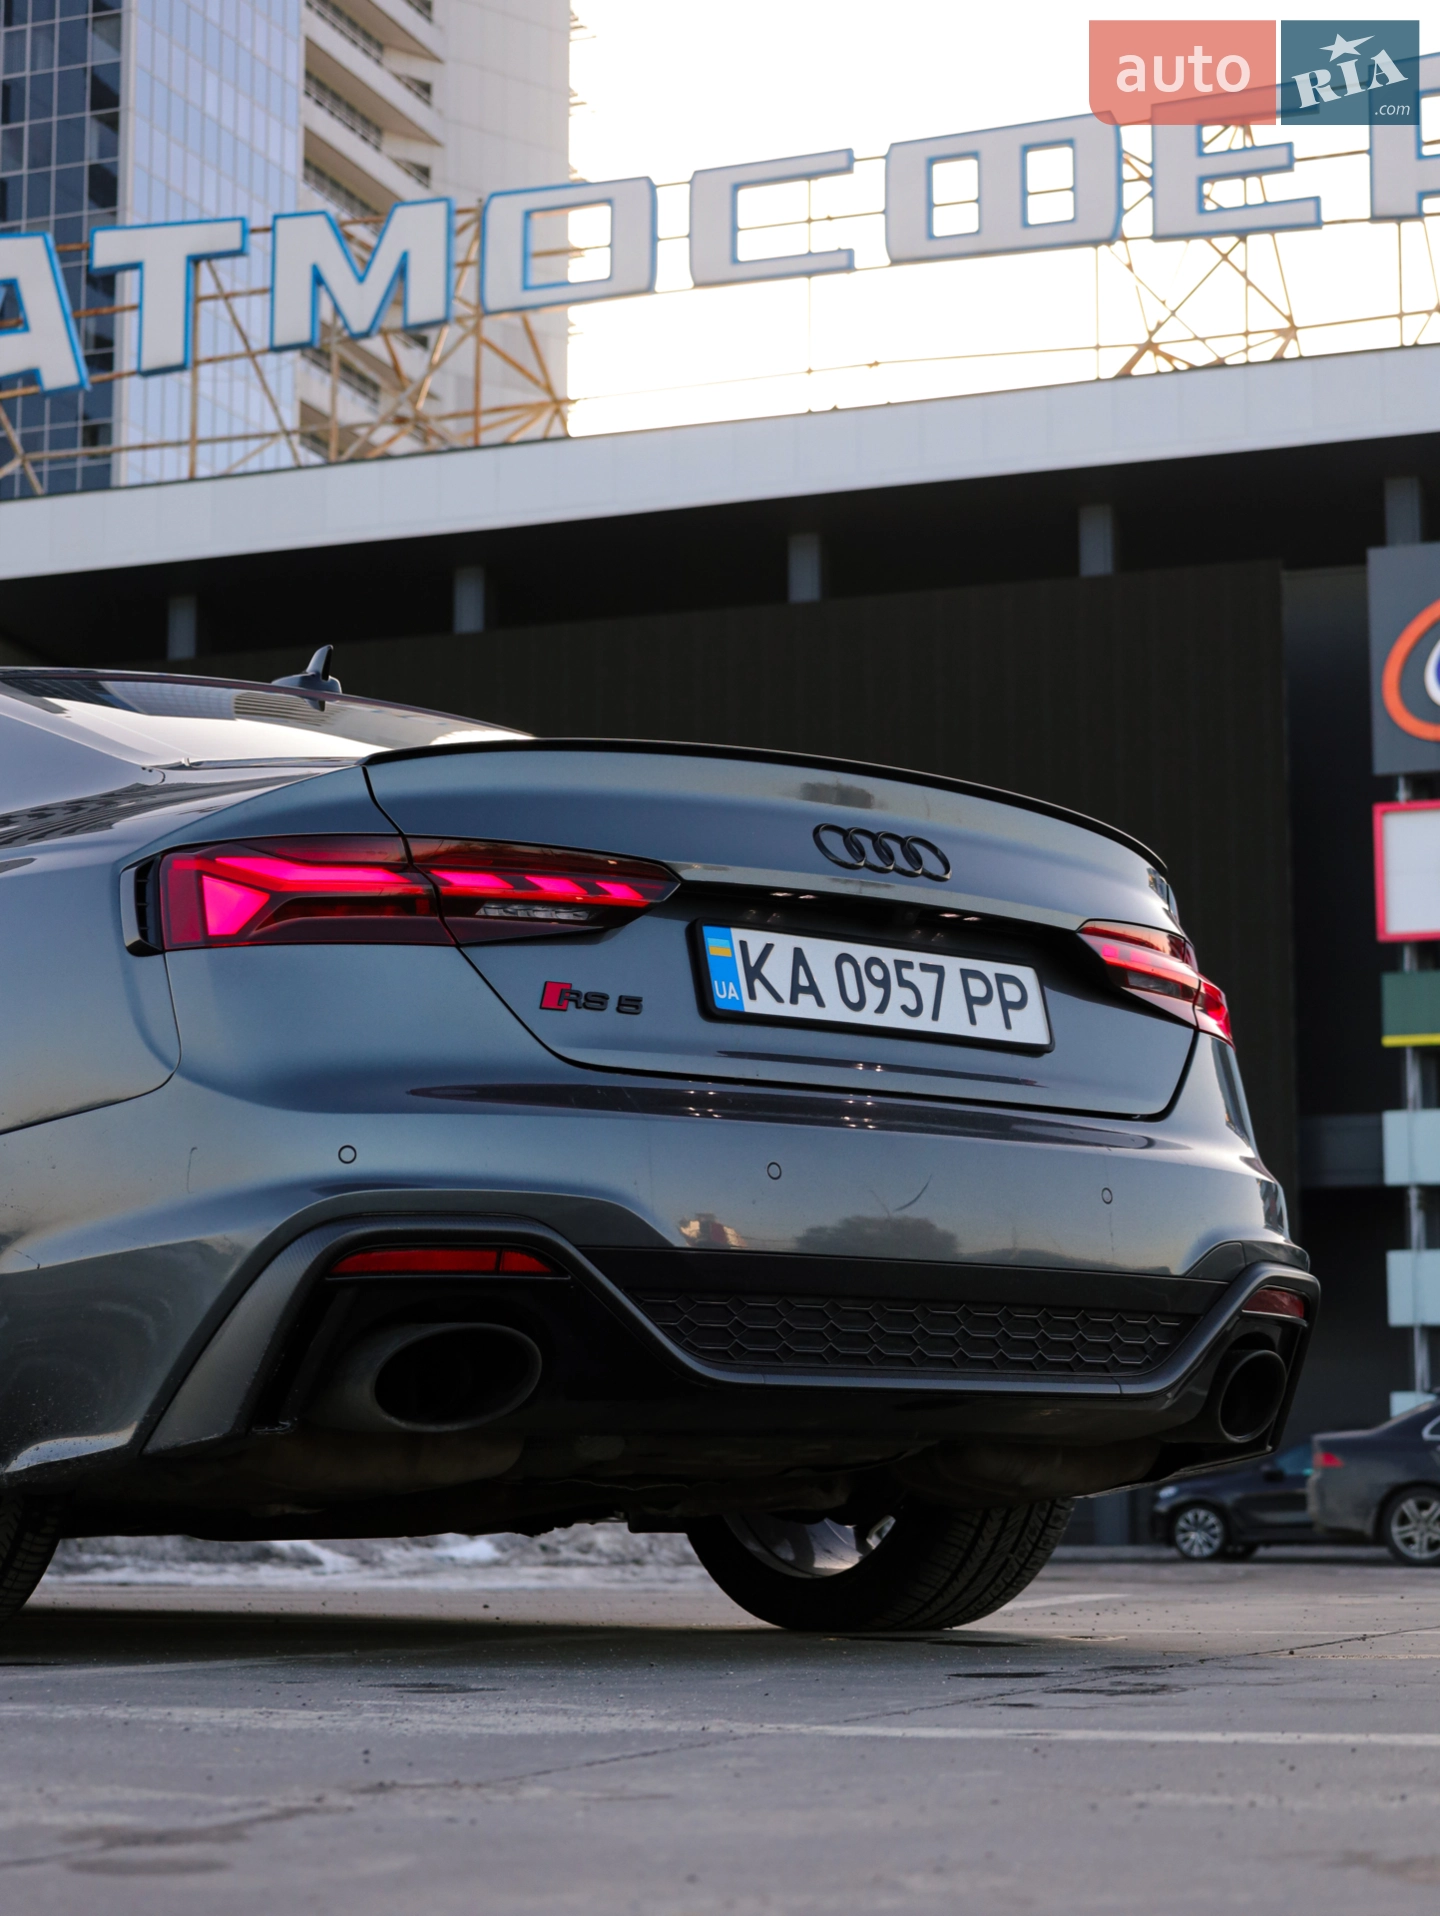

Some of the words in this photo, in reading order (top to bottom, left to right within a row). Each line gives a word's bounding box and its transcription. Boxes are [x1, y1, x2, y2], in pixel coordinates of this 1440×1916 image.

[714, 980, 740, 1001] UA
[738, 940, 826, 1009] KA
[834, 952, 946, 1022] 0957
[959, 967, 1029, 1030] PP
